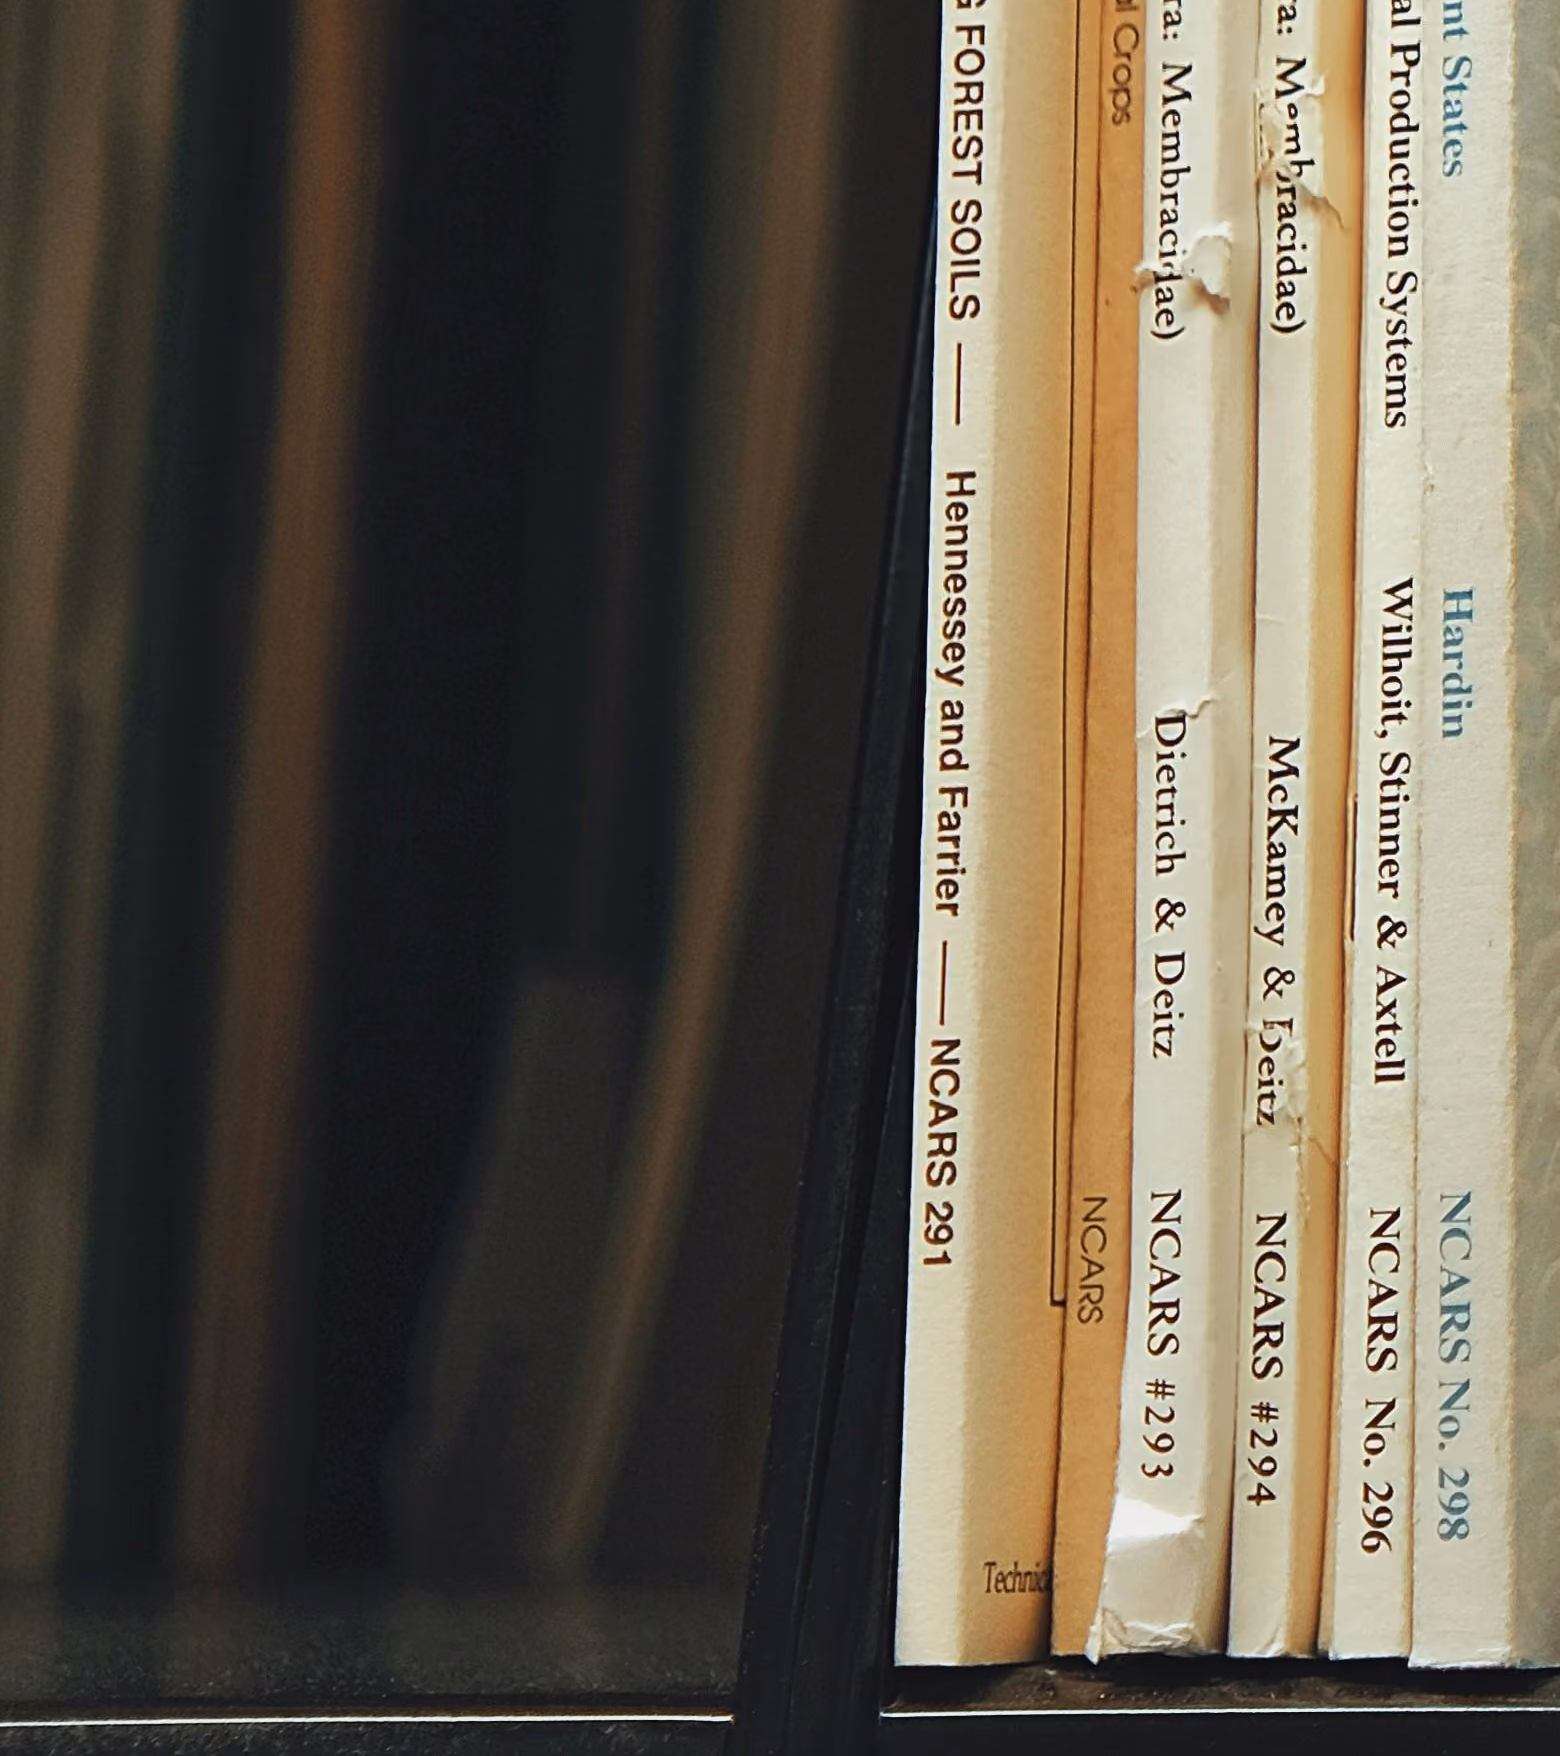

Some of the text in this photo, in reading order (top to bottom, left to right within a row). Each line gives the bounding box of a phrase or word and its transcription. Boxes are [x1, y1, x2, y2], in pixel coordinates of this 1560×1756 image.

[950, 24, 986, 184] FOREST
[1107, 23, 1140, 125] Crops
[1383, 42, 1420, 258] Production
[1440, 55, 1473, 178] States
[947, 199, 983, 319] SOILS
[1377, 270, 1419, 429] Systems
[934, 471, 976, 686] Hennessey
[937, 699, 969, 771] and
[1439, 586, 1473, 740] Hardin
[933, 786, 967, 916] Farrier
[1150, 713, 1189, 1059] Dietrich & Deitz
[1256, 736, 1301, 946] McKamey
[1371, 577, 1413, 1084] Wilhoit, Stinner & Axtell
[1261, 965, 1295, 1001] &
[925, 1038, 959, 1187] NCARS
[923, 1201, 955, 1267] 291
[1077, 1196, 1107, 1324] NCARS
[1139, 1190, 1183, 1479] NCARS #293
[1245, 1212, 1288, 1507] NCARS #294
[1358, 1207, 1401, 1554] NCARS No. 296
[1435, 1192, 1472, 1542] NCARS No. 298
